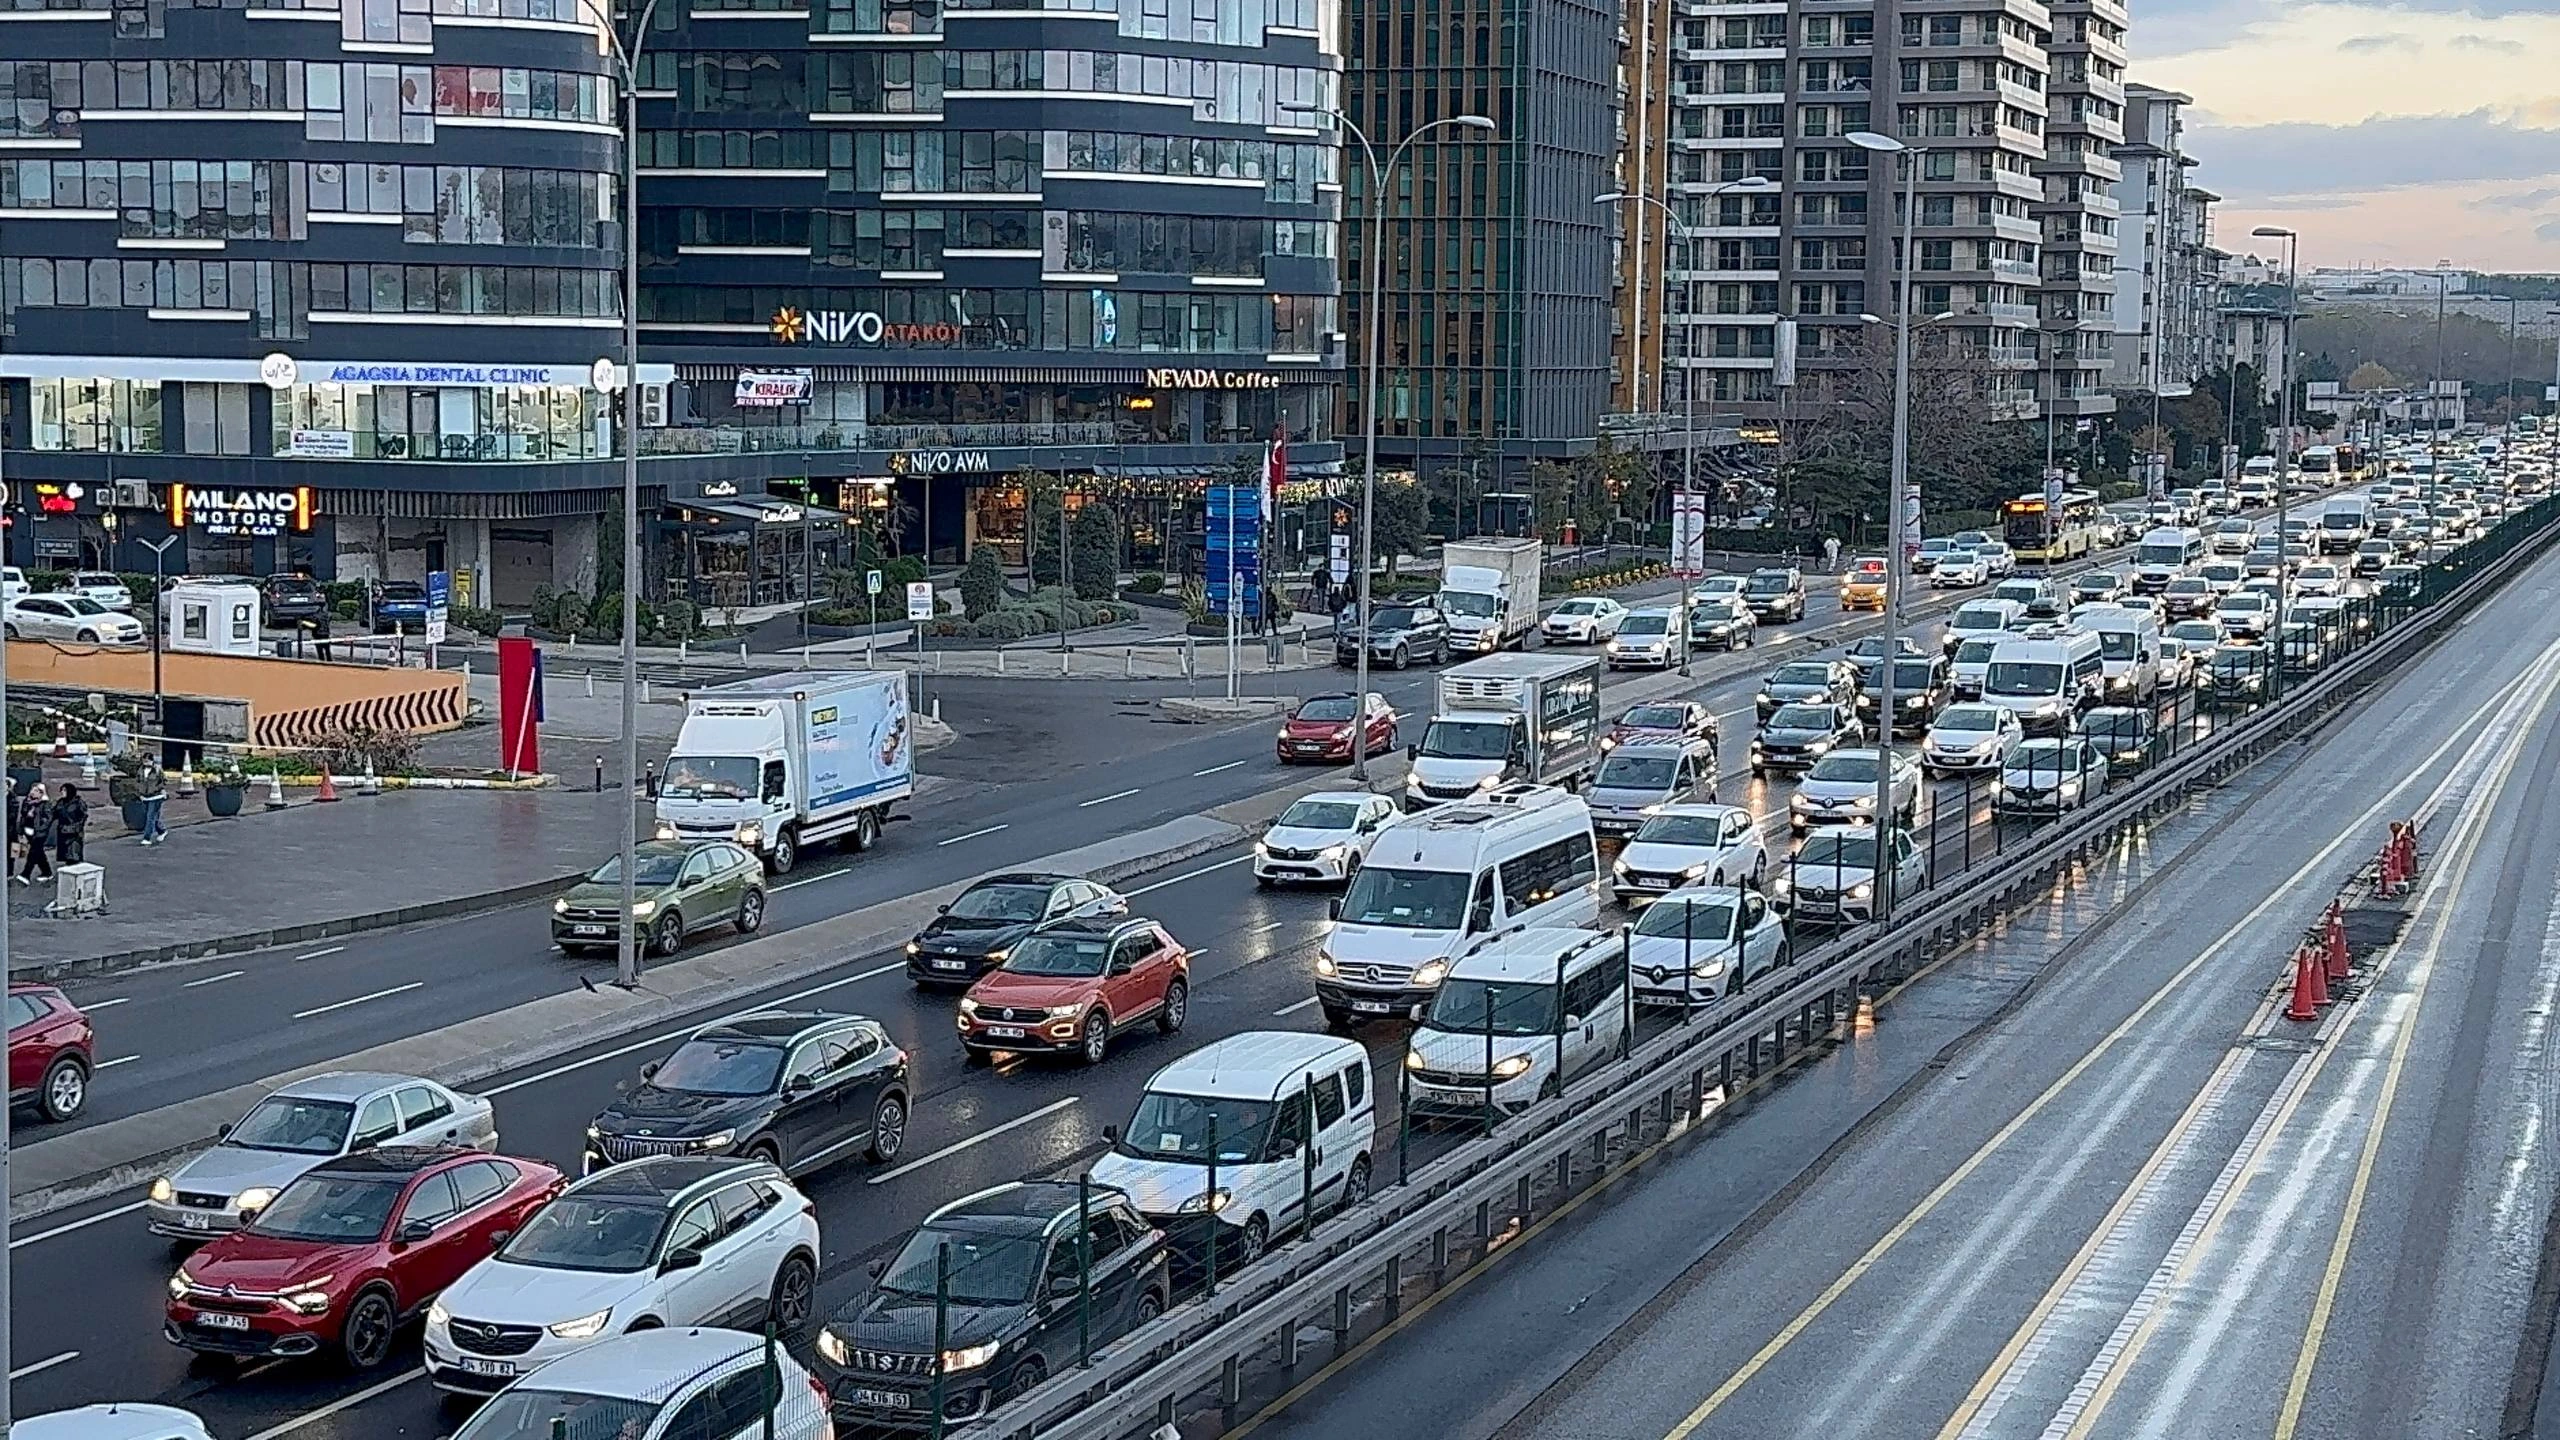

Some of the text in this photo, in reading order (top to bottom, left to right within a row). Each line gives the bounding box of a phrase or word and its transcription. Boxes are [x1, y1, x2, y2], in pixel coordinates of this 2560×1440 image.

[805, 311, 962, 342] NiVO ATAKÖY
[330, 366, 551, 383] AGAGSIA DENTAL CLINIC
[1146, 369, 1280, 388] NEVADA Coffee
[911, 451, 989, 472] NiVO AVM
[184, 490, 298, 511] MILANO
[194, 511, 287, 526] MOTORS
[207, 525, 278, 536] RENT A CAR
